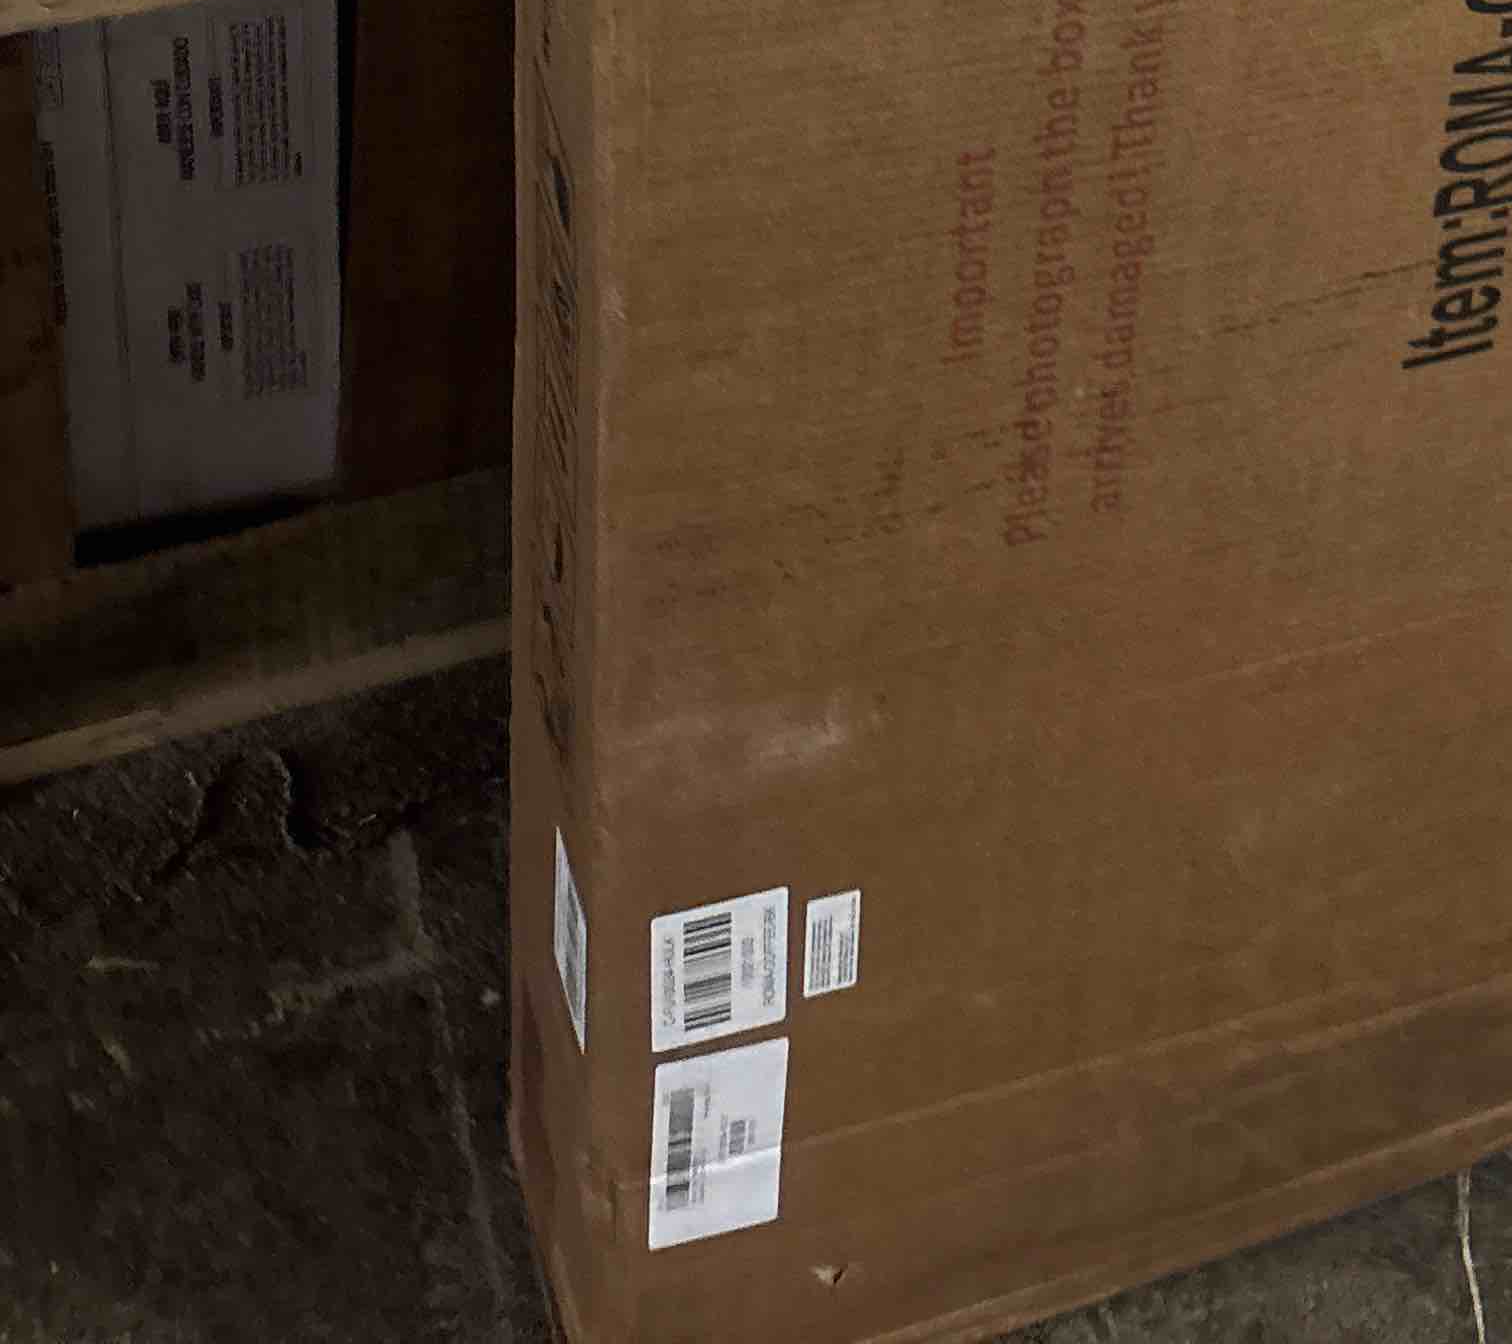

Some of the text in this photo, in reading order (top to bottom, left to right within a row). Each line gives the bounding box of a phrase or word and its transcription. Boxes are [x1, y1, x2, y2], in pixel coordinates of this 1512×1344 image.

[1043, 0, 1085, 74] box
[1113, 19, 1167, 159] Thank
[1035, 89, 1081, 160] the
[941, 145, 995, 364] Important
[1015, 162, 1078, 411] photograph
[1097, 169, 1154, 368] damaged!
[1082, 379, 1133, 513] arrives
